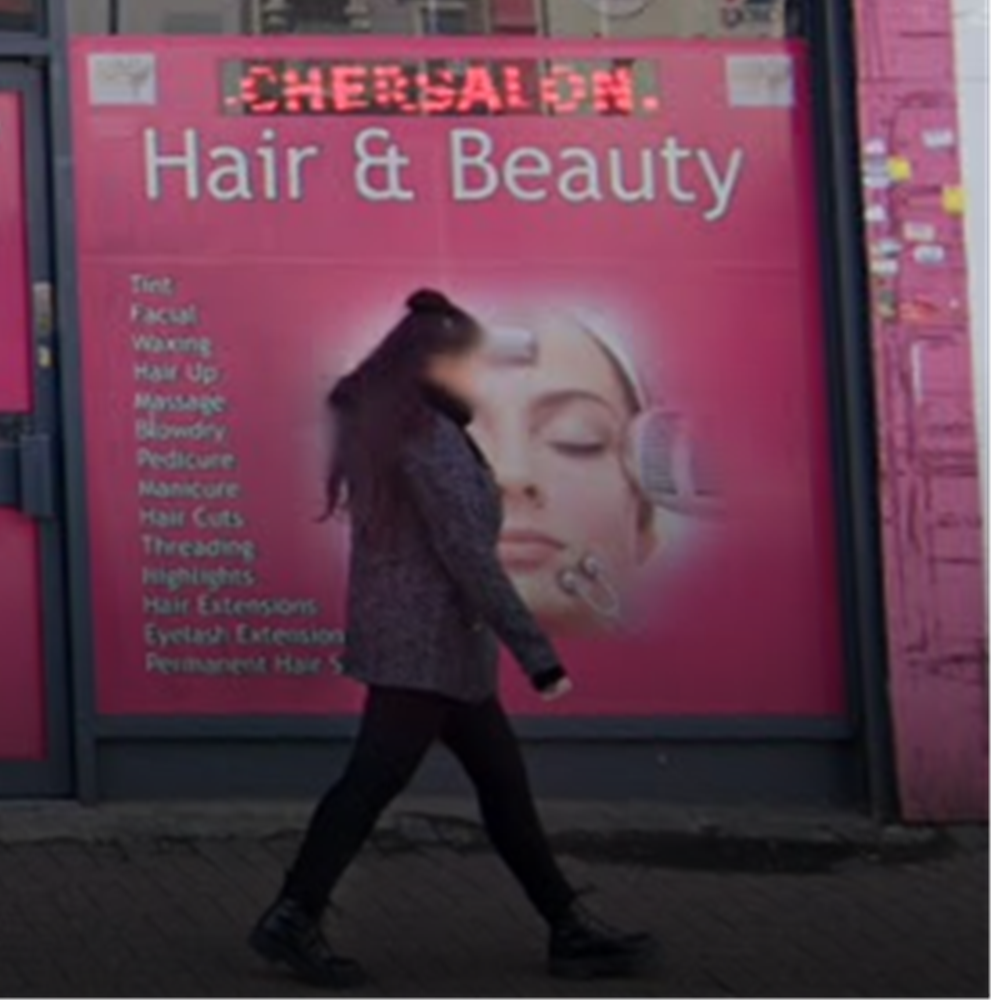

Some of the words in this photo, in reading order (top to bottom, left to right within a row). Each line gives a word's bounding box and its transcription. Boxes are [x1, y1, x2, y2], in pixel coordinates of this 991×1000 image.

[144, 127, 317, 201] Hair
[354, 127, 415, 201] &
[450, 127, 744, 221] Beauty
[130, 274, 176, 297] Tint
[131, 303, 198, 326] Facial
[131, 334, 213, 358] Waxing
[133, 363, 179, 383] Hair
[186, 363, 220, 387] Up
[133, 392, 228, 417] Massage
[135, 417, 228, 443] Blowdry
[137, 449, 239, 471] Pedicure
[138, 478, 241, 499] Manicure
[139, 507, 186, 528] Hair
[193, 506, 245, 528] Cuts
[141, 535, 256, 563] Threading
[142, 566, 256, 591] Highlights
[142, 595, 190, 617] Hair
[197, 595, 320, 618] Extensions
[145, 623, 228, 648] Eyelash
[145, 652, 269, 675] Permanent
[274, 653, 322, 675] Hair
